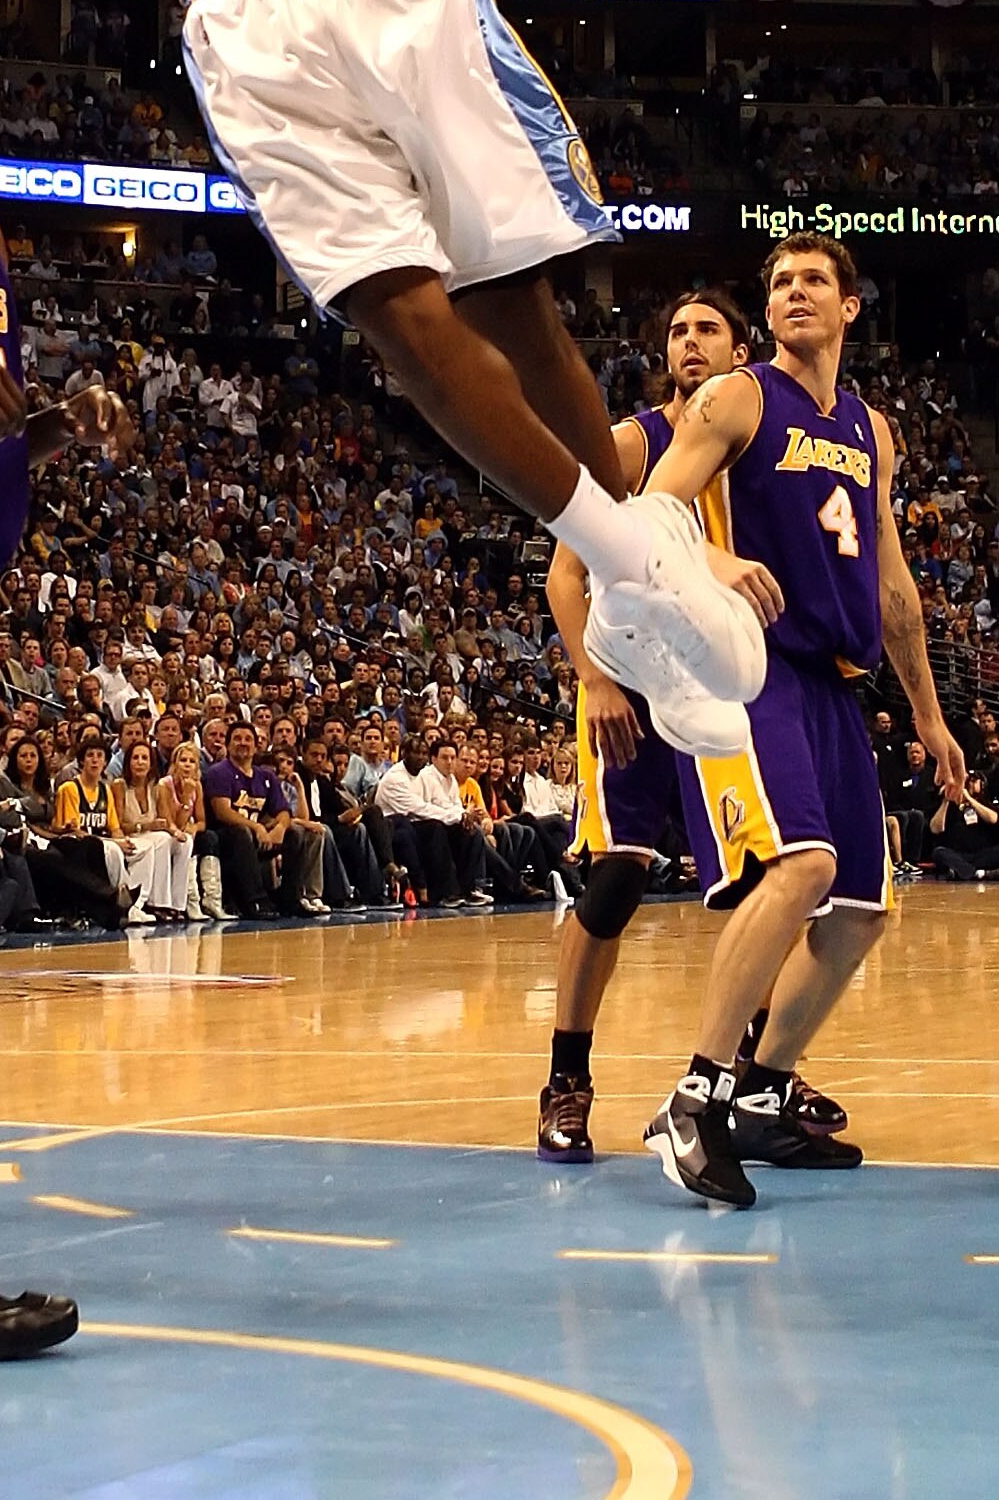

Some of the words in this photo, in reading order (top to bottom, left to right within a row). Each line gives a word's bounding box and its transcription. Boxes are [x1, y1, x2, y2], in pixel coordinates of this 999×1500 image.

[93, 177, 199, 202] GEICO
[209, 181, 245, 209] G
[741, 203, 904, 238] High-Speed
[911, 207, 999, 235] Intern
[774, 428, 871, 488] LAKERS
[817, 485, 860, 558] 4
